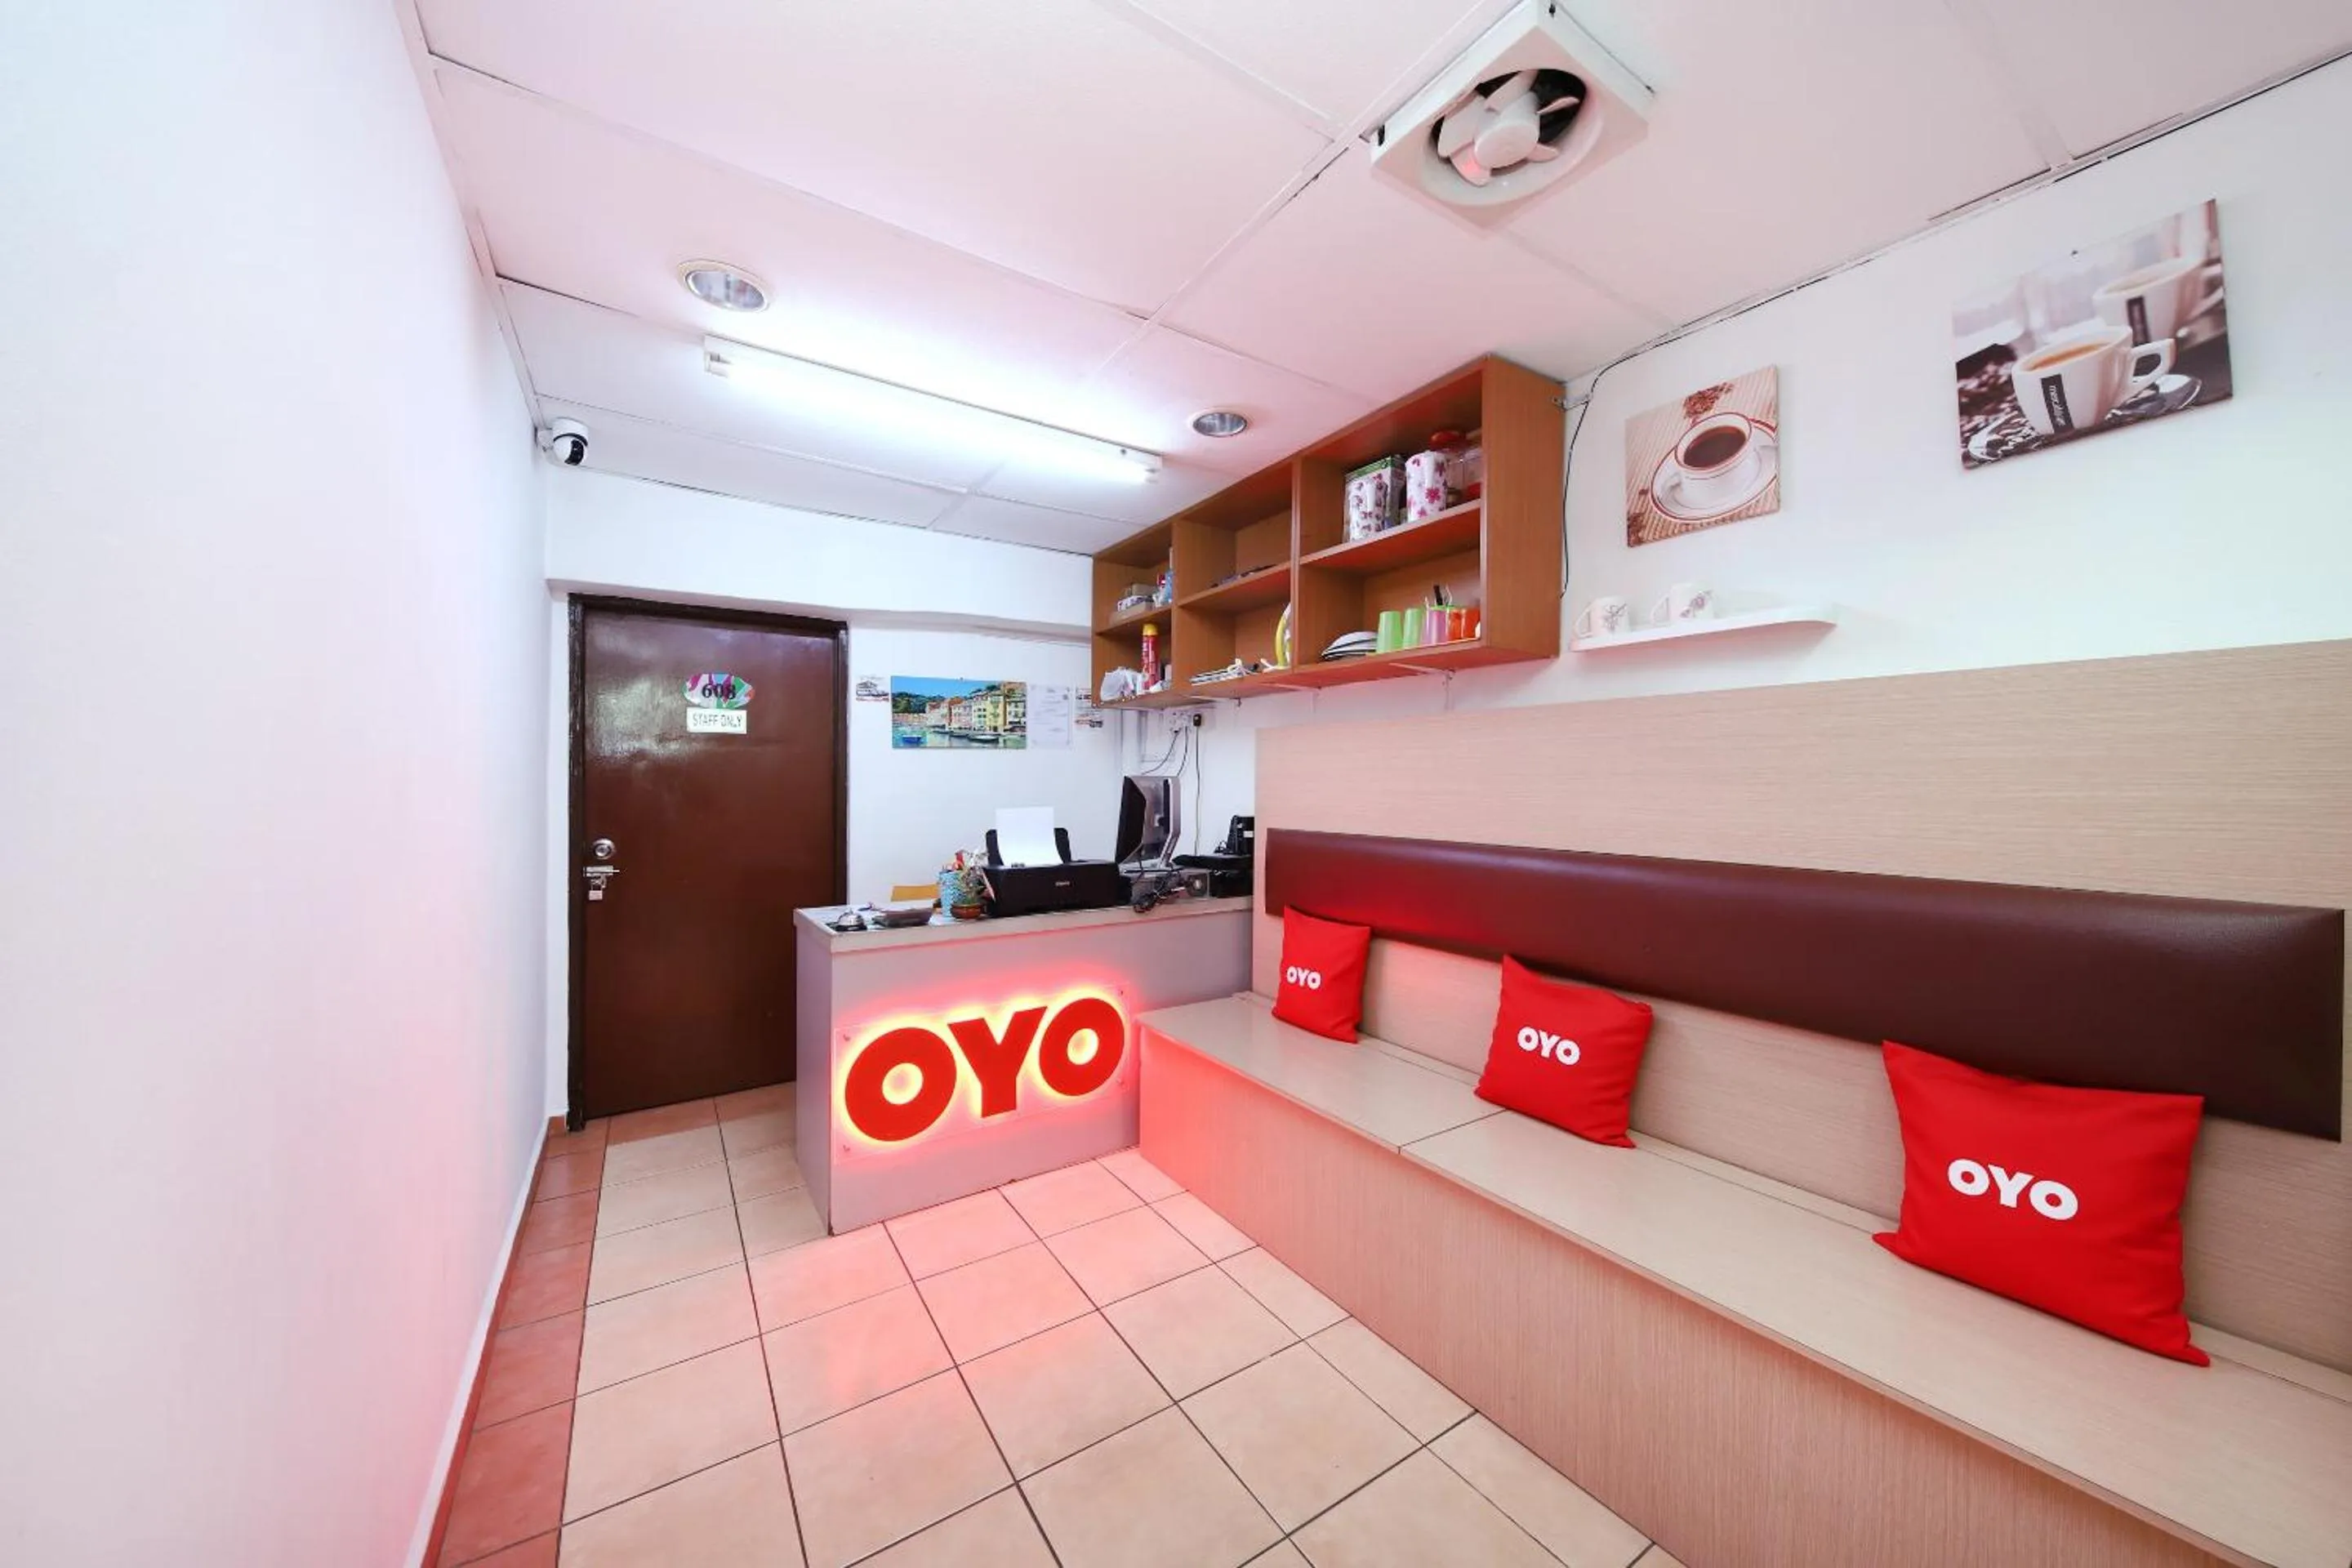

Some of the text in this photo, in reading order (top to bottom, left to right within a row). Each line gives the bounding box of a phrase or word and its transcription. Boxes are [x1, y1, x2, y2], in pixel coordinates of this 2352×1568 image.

[702, 683, 736, 700] 608
[693, 712, 742, 728] STAFF ONLY
[1287, 965, 1321, 990] OYO
[1517, 1026, 1580, 1066] OYO
[844, 997, 1125, 1142] OYO
[1948, 1158, 2078, 1221] OYO
